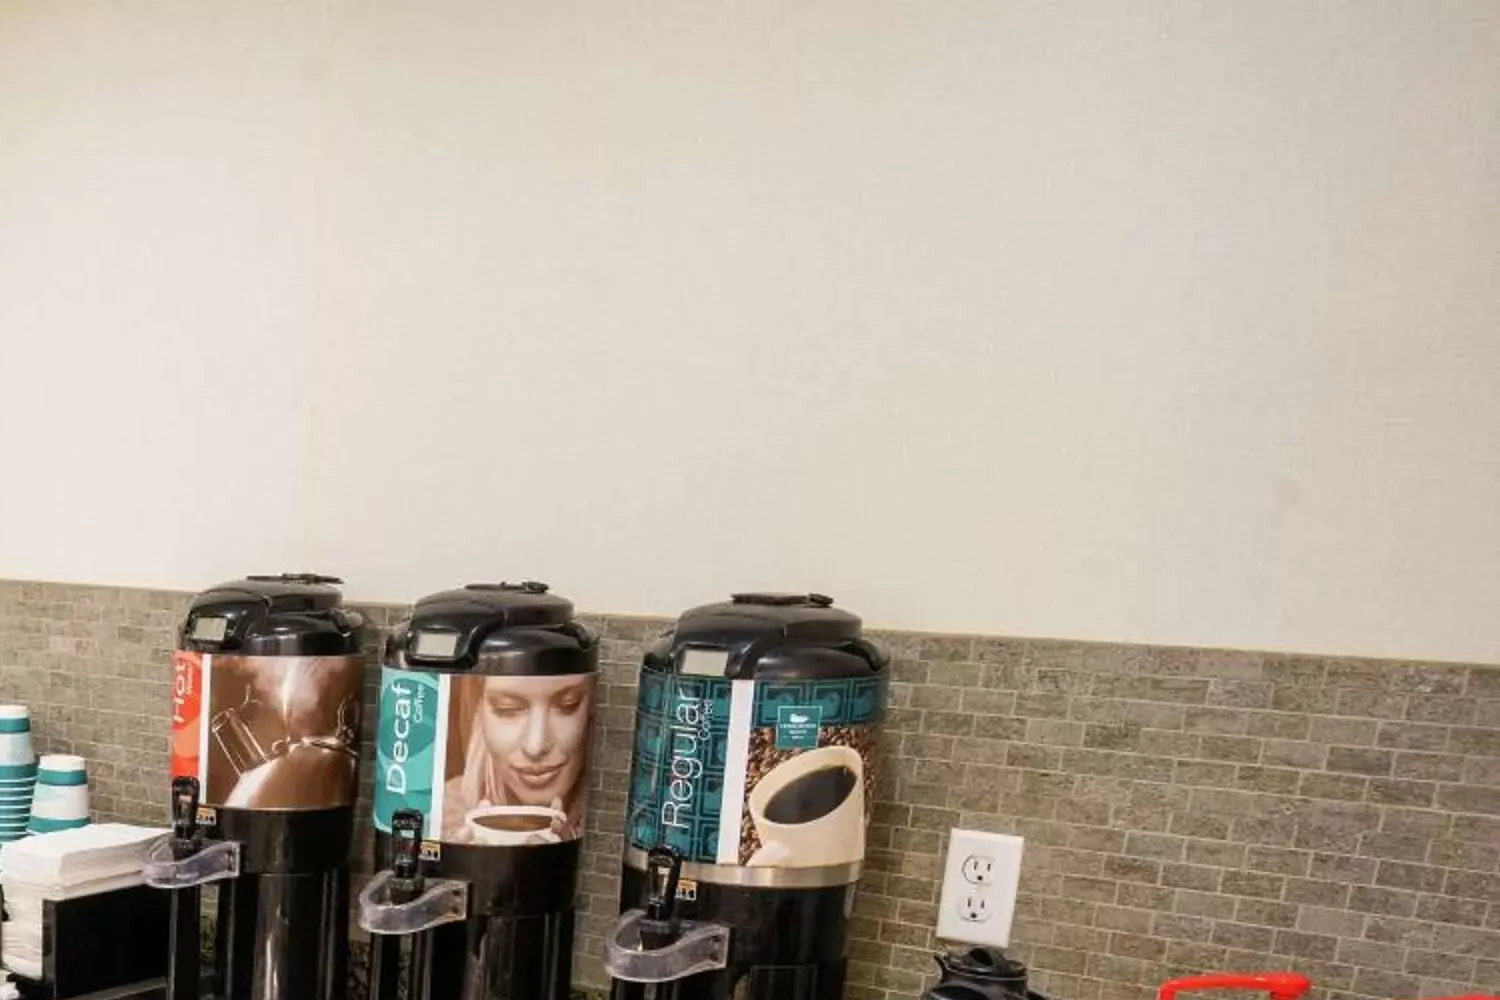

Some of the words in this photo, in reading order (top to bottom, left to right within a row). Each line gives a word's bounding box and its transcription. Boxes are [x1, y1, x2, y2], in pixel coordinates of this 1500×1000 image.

[173, 659, 185, 724] Hot
[413, 683, 425, 723] Coffee
[386, 682, 412, 795] Decaf
[661, 688, 703, 829] Regular
